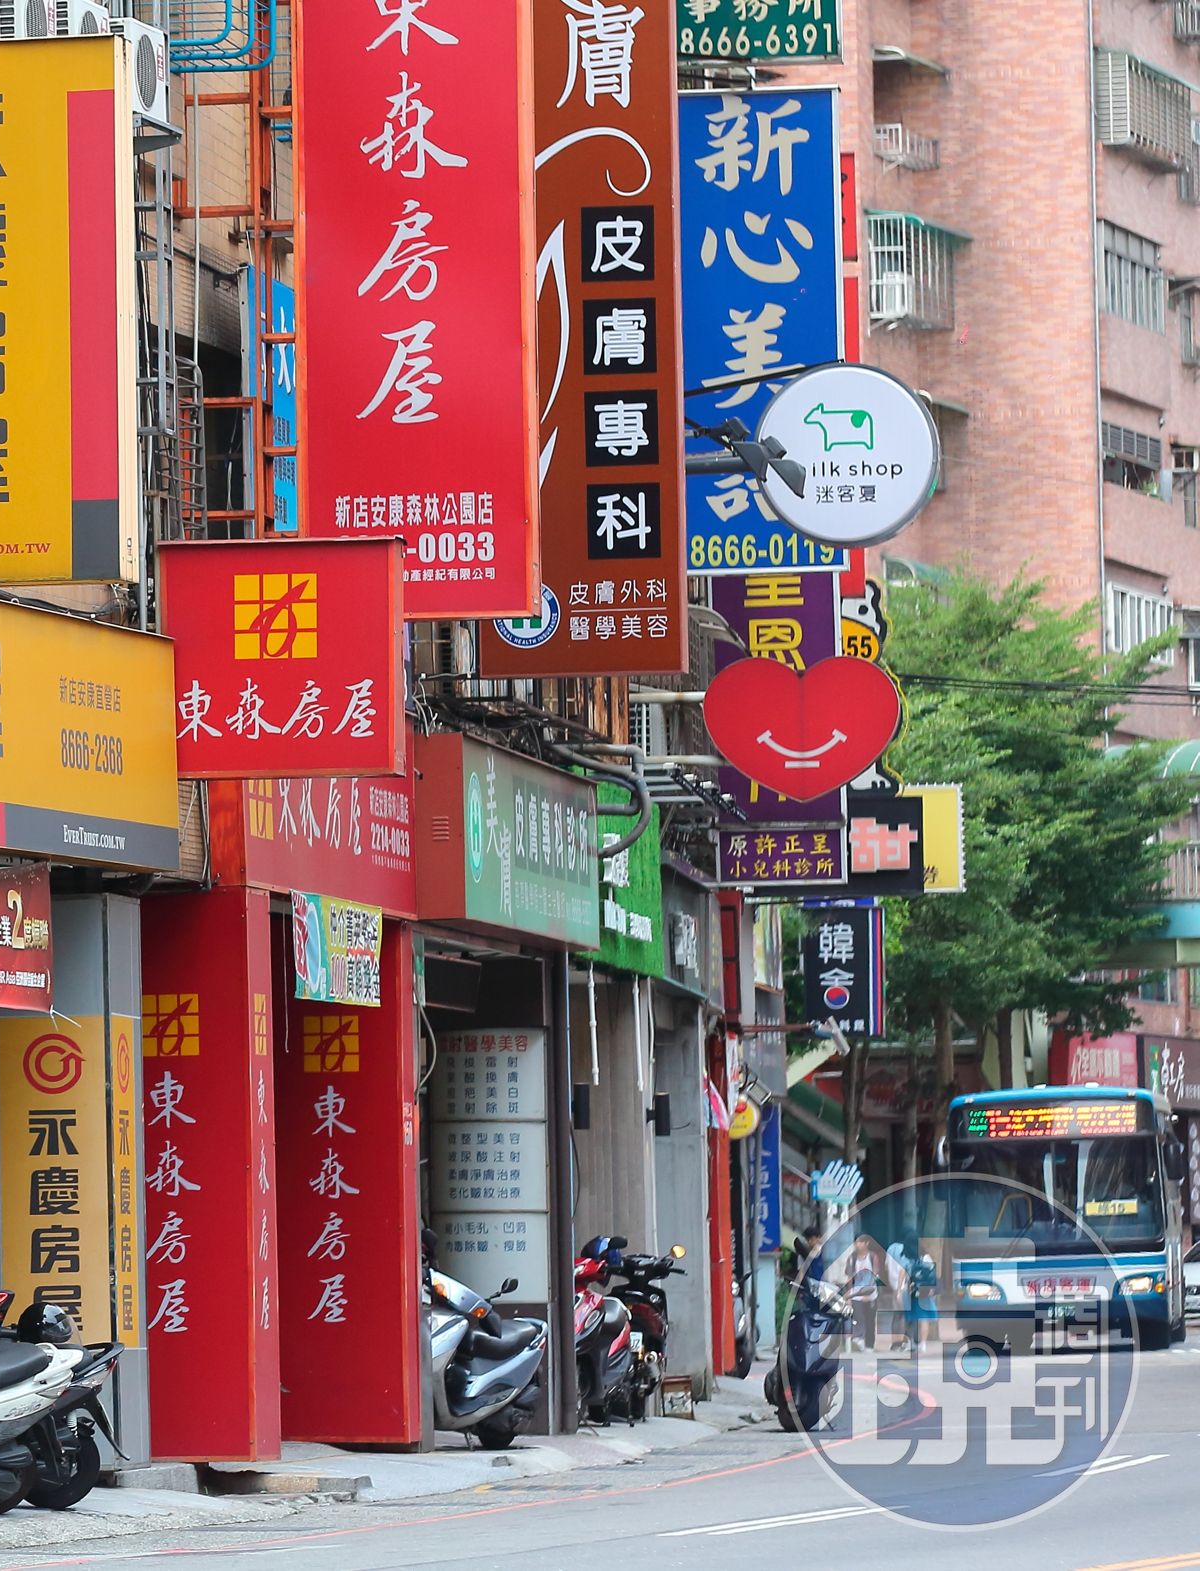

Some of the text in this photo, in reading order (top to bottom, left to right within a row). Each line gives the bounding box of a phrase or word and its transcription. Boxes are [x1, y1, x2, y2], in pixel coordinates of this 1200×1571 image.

[680, 24, 833, 55] 8666-6391
[588, 215, 652, 552] 皮膚專科
[849, 461, 903, 479] shop
[335, 491, 494, 528] 新店安康森林公園店
[816, 485, 877, 503] 迷客夏
[402, 531, 495, 563] -0033
[690, 534, 834, 565] 8666-0119
[568, 578, 668, 606] 皮膚外科
[568, 614, 668, 641] 醫學美容
[842, 640, 872, 659] 55
[59, 674, 121, 713] 新店安康直營店
[176, 678, 377, 742] 東森房屋
[61, 727, 124, 776] 8666-2368
[370, 821, 411, 858] 2214-0033
[515, 789, 589, 876] 皮膚專科診所
[727, 834, 832, 856] 原許正呈
[729, 860, 834, 878] 小兒科診所
[145, 1071, 200, 1333] 東森房屋
[306, 1085, 360, 1323] 東森房屋
[118, 1110, 134, 1331] 永慶房屋
